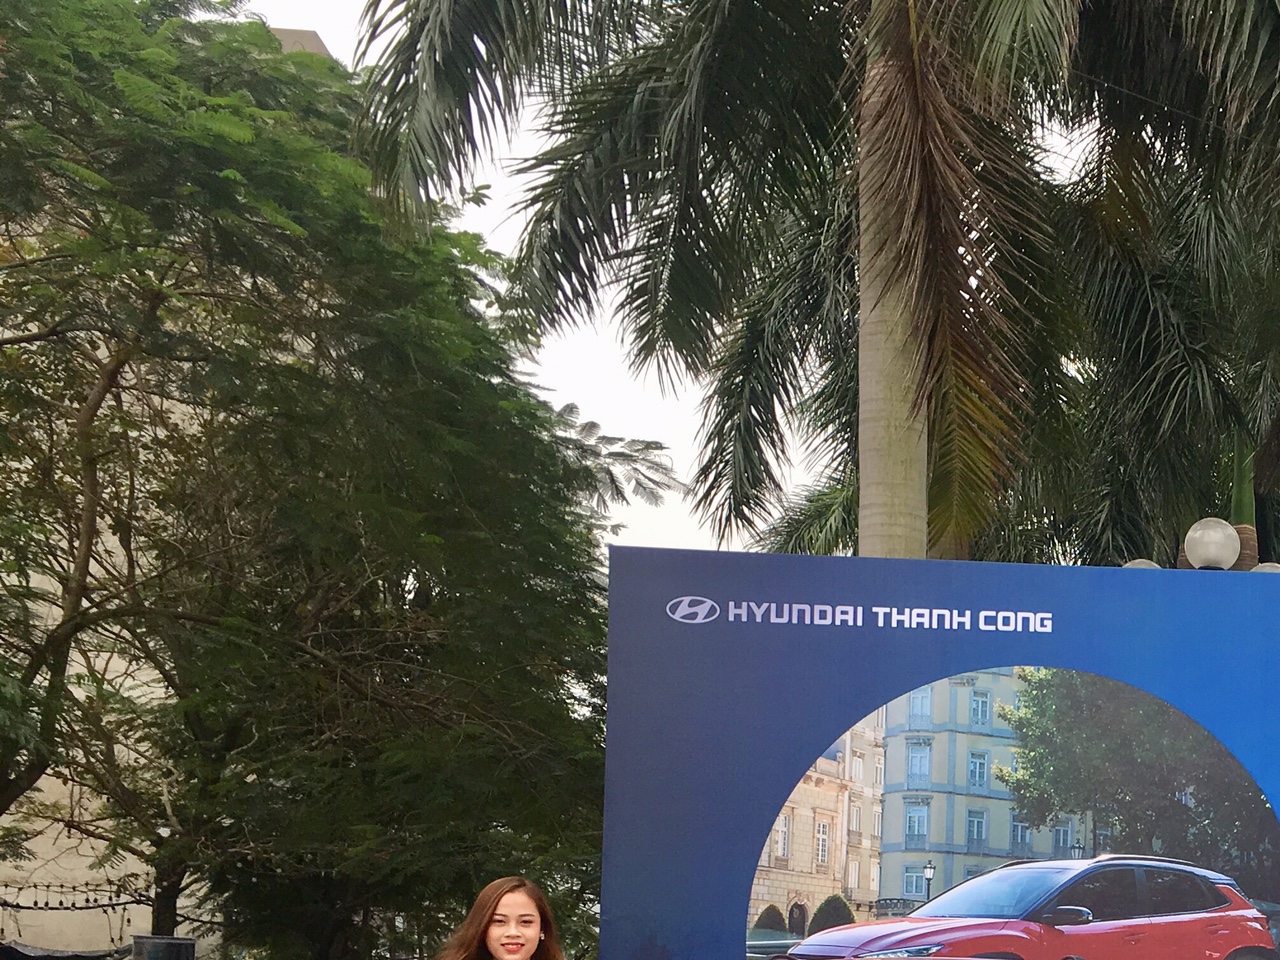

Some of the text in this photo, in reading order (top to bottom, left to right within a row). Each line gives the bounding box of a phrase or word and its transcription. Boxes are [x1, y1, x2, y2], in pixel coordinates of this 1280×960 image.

[728, 601, 1053, 633] HYUNDAI THANH CONG
